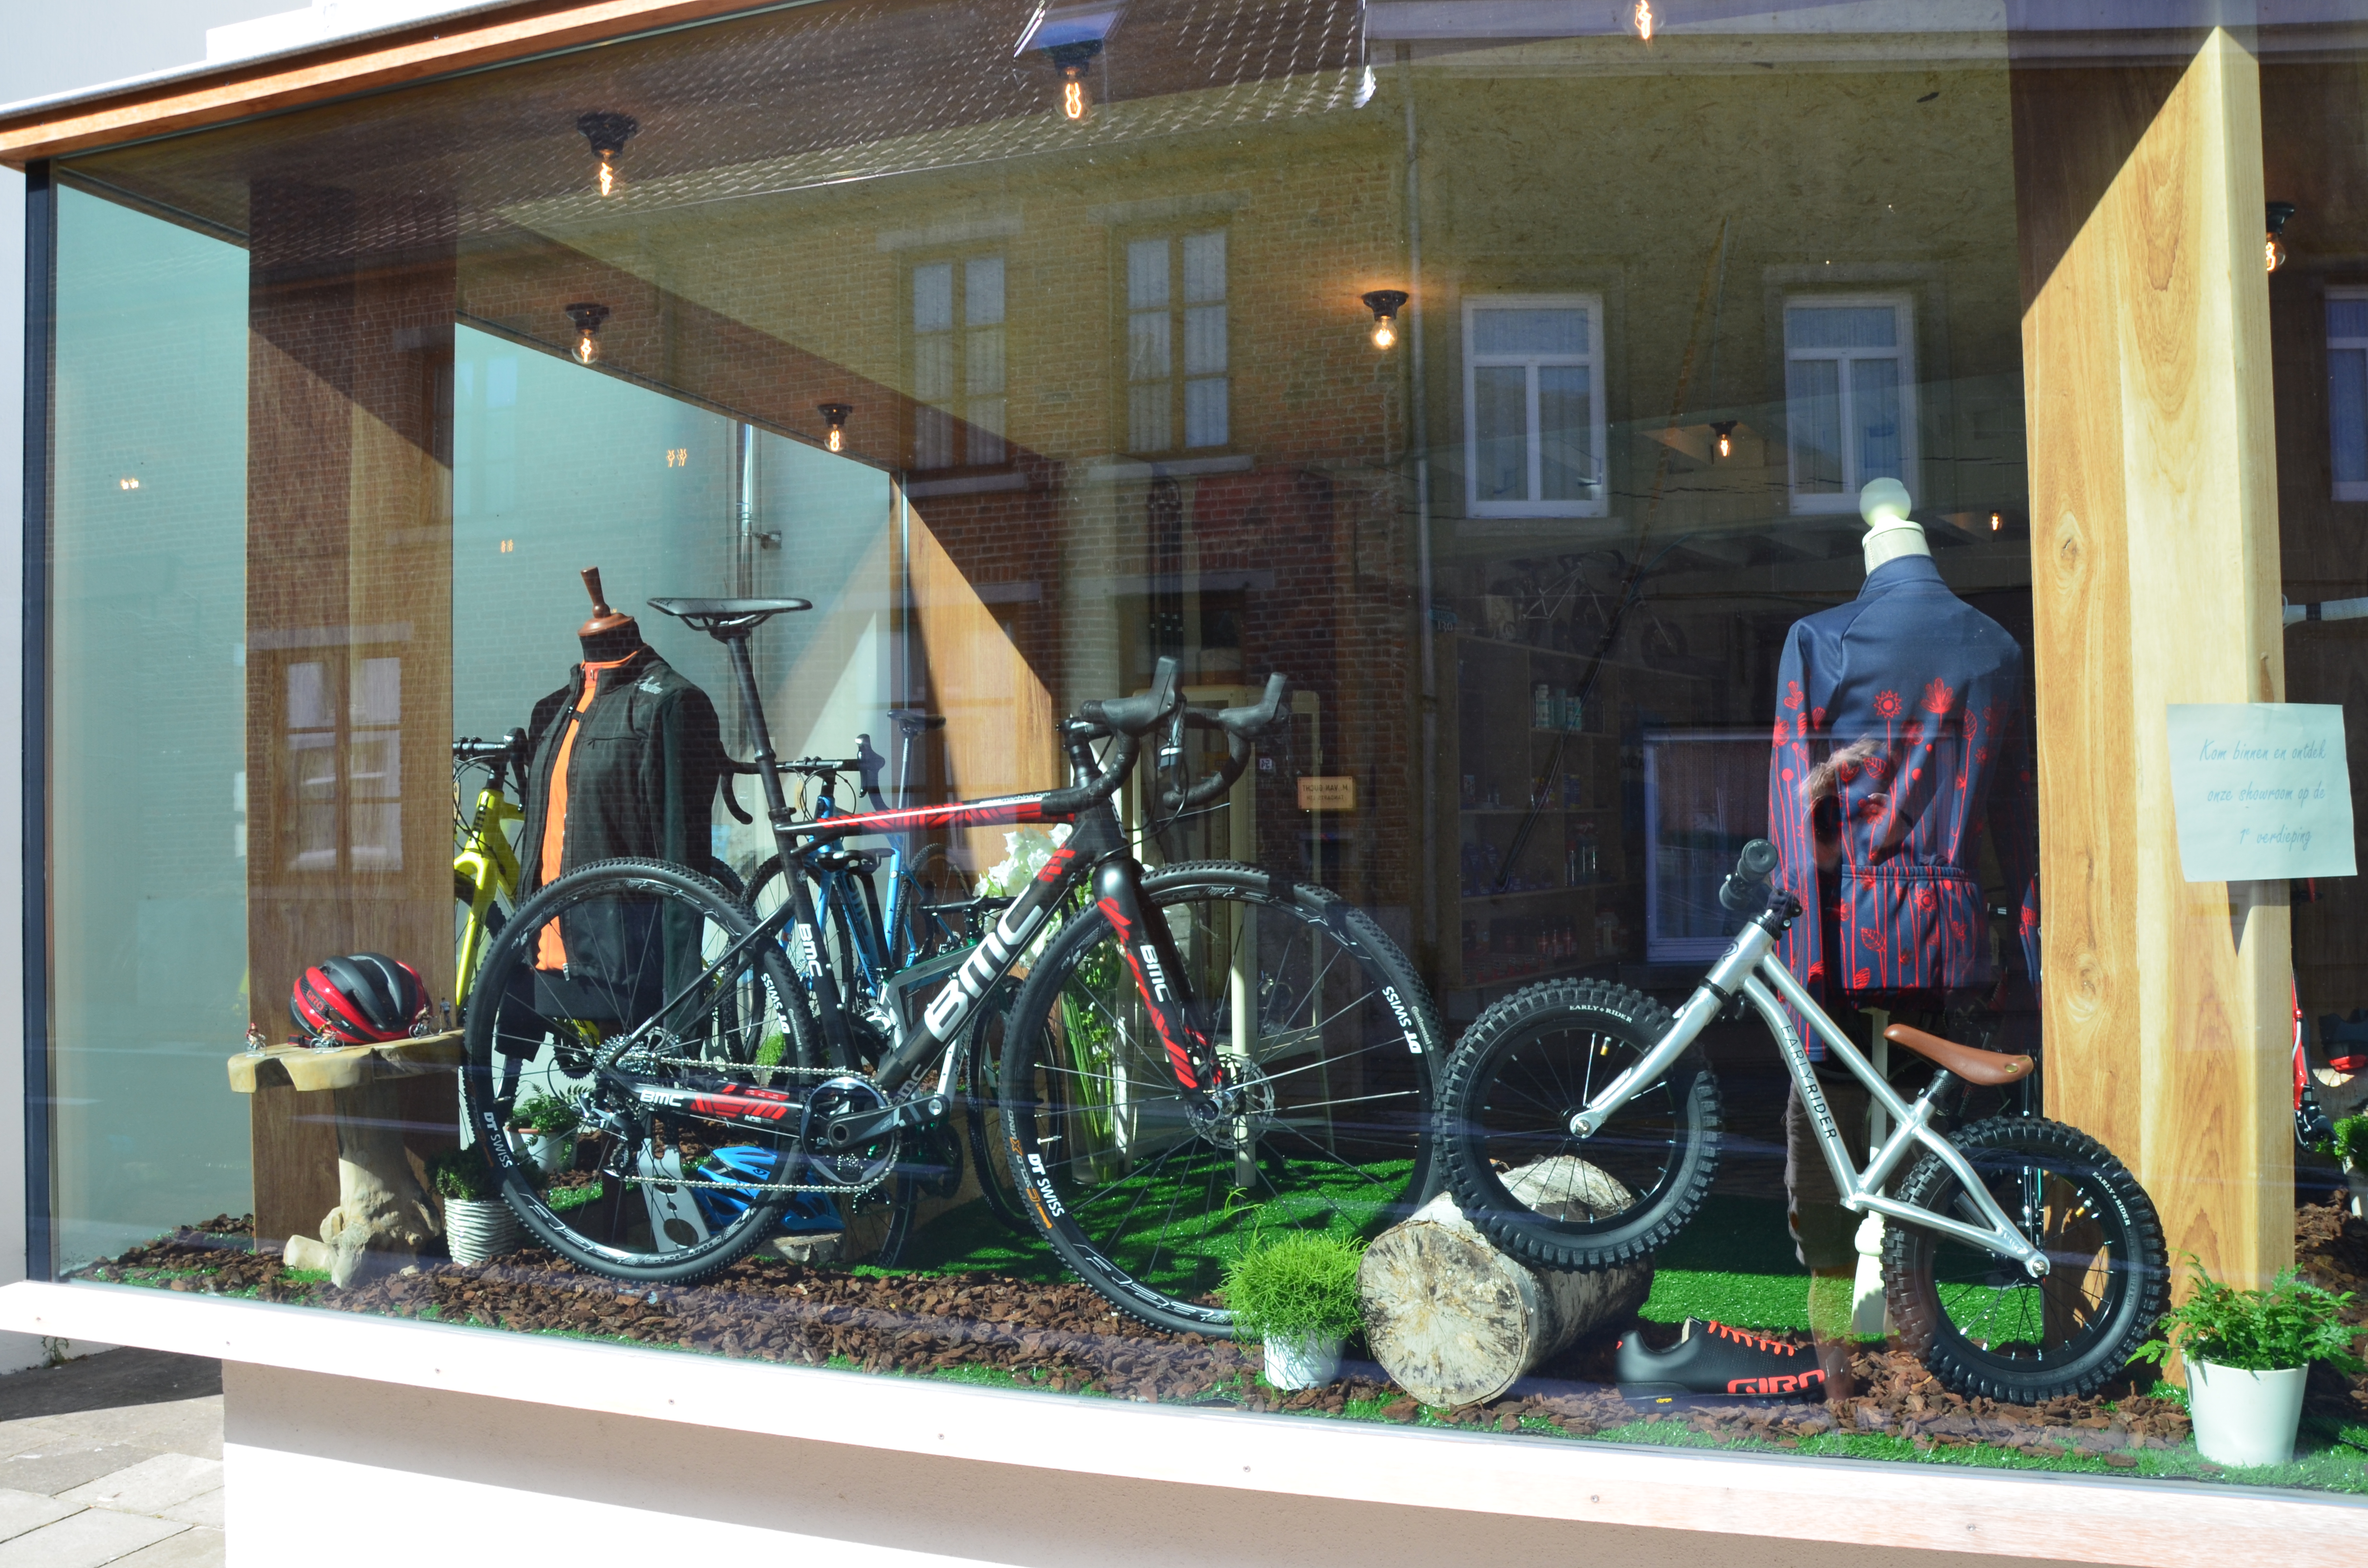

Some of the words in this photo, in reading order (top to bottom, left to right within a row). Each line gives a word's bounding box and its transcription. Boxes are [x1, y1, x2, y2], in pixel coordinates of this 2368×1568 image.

[2199, 739, 2227, 761] Kom
[2232, 740, 2268, 761] binnen
[2274, 749, 2286, 759] en
[2292, 739, 2326, 759] ontdek
[2208, 789, 2232, 802] onze
[2239, 781, 2293, 801] showroom
[2298, 787, 2309, 808] op
[2314, 781, 2325, 799] de
[2257, 824, 2312, 852] verdieping
[798, 923, 823, 977] BMC
[924, 883, 1044, 1042] BMC
[1140, 944, 1172, 1002] BMC
[306, 990, 324, 1011] GIRO
[761, 973, 783, 1009] SWISS
[1382, 986, 1412, 1027] SWISS
[1605, 1008, 1633, 1023] RIDER
[777, 1012, 790, 1034] DT
[1411, 1006, 1432, 1045] Continental
[1404, 1030, 1422, 1054] DT
[1781, 1025, 1813, 1080] EARLY
[1805, 1083, 1838, 1139] RIDER
[640, 1089, 684, 1107] BMC
[484, 1112, 498, 1131] DT
[744, 1115, 762, 1123] ACE
[490, 1134, 513, 1168] SWISS
[1027, 1153, 1046, 1175] DT
[1037, 1178, 1065, 1217] SWISS
[2092, 1171, 2115, 1195] EARLY
[2115, 1199, 2131, 1226] RIDER
[1727, 1369, 1825, 1394] GIRO
